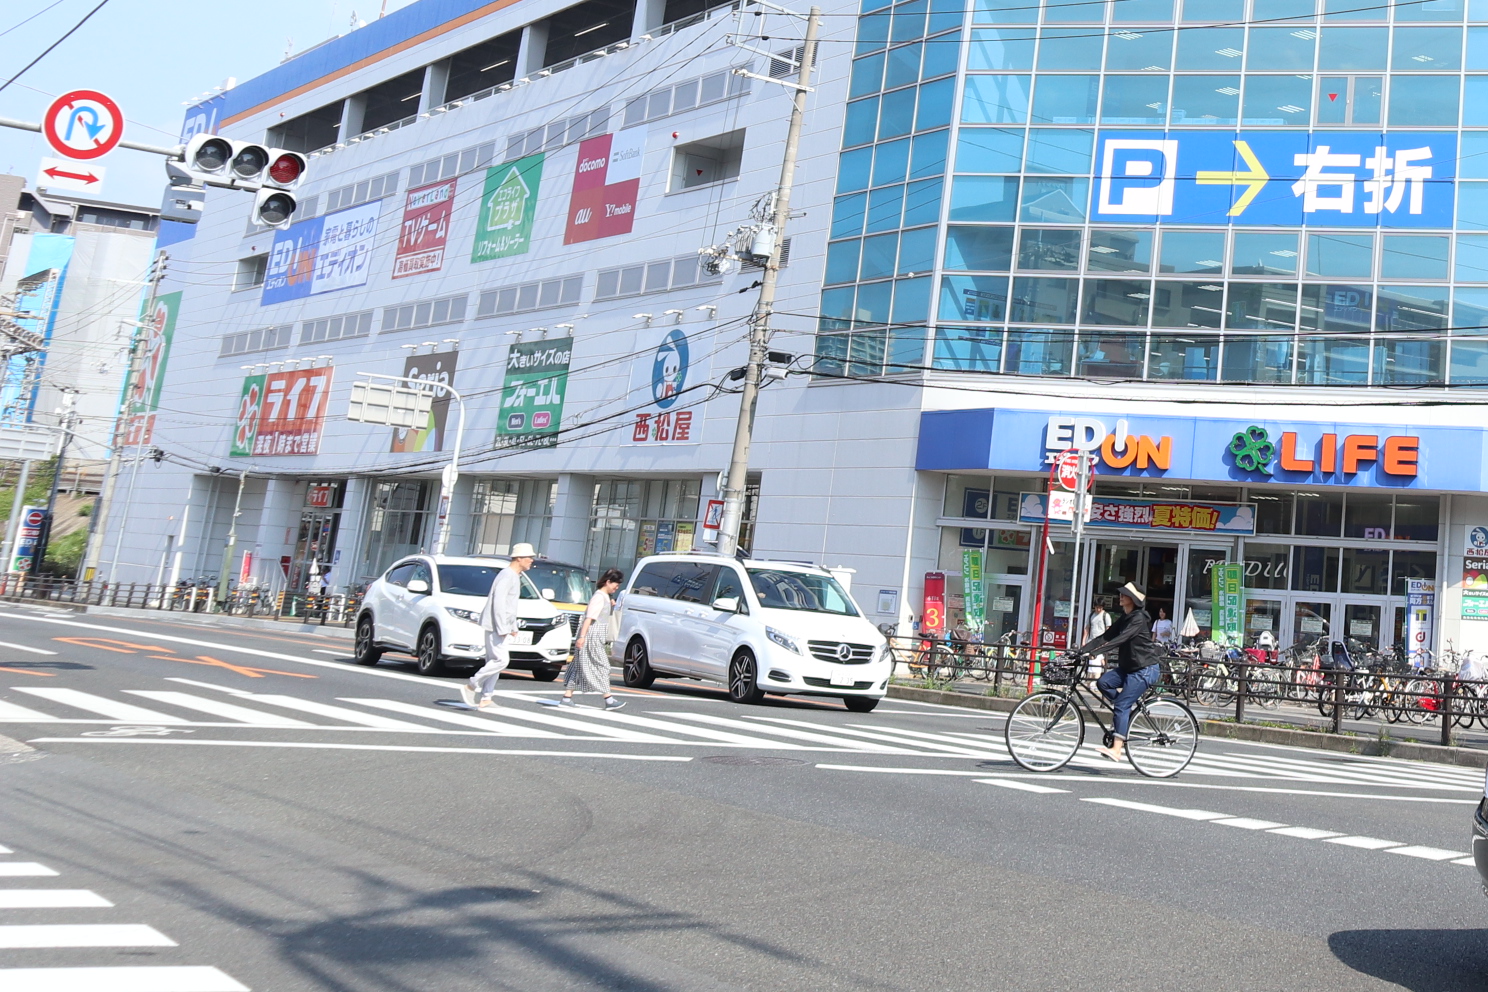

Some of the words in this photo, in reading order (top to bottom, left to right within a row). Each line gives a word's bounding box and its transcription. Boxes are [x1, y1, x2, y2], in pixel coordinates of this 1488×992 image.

[619, 148, 640, 161] SoftBank
[1105, 144, 1169, 210] P
[1292, 145, 1433, 215] 右折
[402, 210, 446, 248] TVゲーム
[575, 207, 593, 225] au
[315, 244, 369, 280] エディオン
[507, 348, 571, 369] 大きいサイズの店
[265, 375, 328, 422] ライフ
[503, 377, 561, 408] フォーエル
[632, 410, 693, 442] 西松屋
[1045, 416, 1173, 470] EDION
[1280, 432, 1420, 476] LIFE
[1060, 464, 1079, 479] 消火
[926, 607, 939, 627] 3
